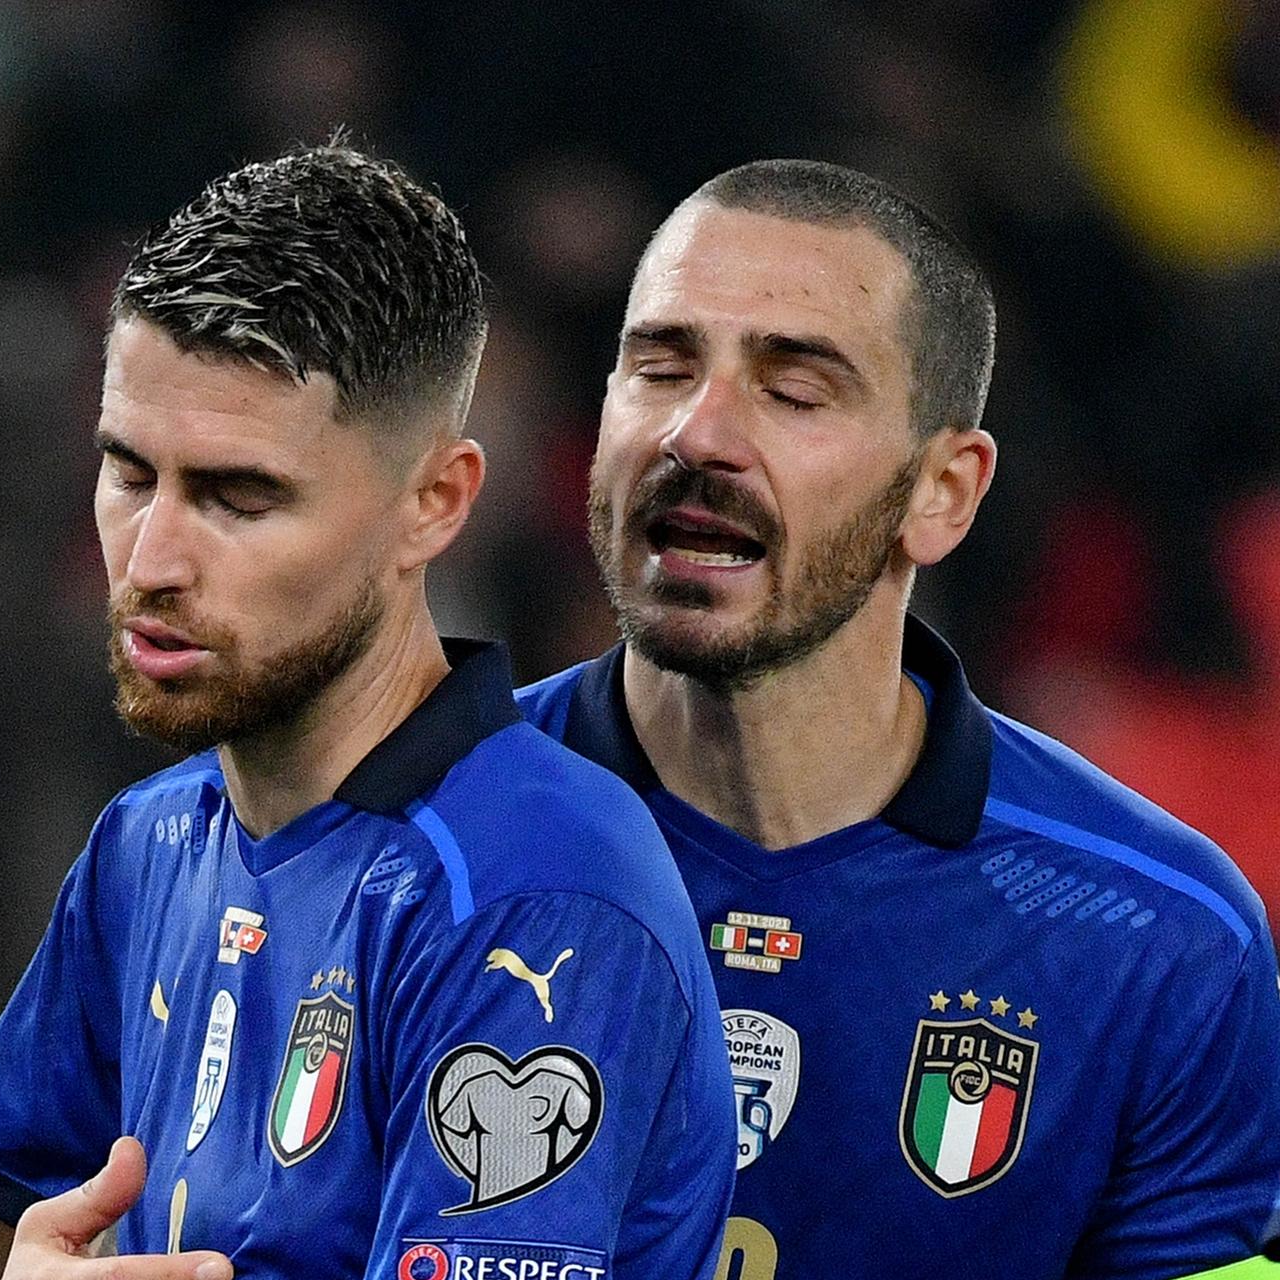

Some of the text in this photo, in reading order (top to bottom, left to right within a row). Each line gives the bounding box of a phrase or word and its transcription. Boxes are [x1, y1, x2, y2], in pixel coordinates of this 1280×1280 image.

[298, 1009, 349, 1039] ITALIA
[723, 1018, 768, 1038] UEFA
[724, 1039, 783, 1058] ROPEAN
[926, 1033, 1024, 1074] ITALIA
[729, 1054, 782, 1071] MPIONS
